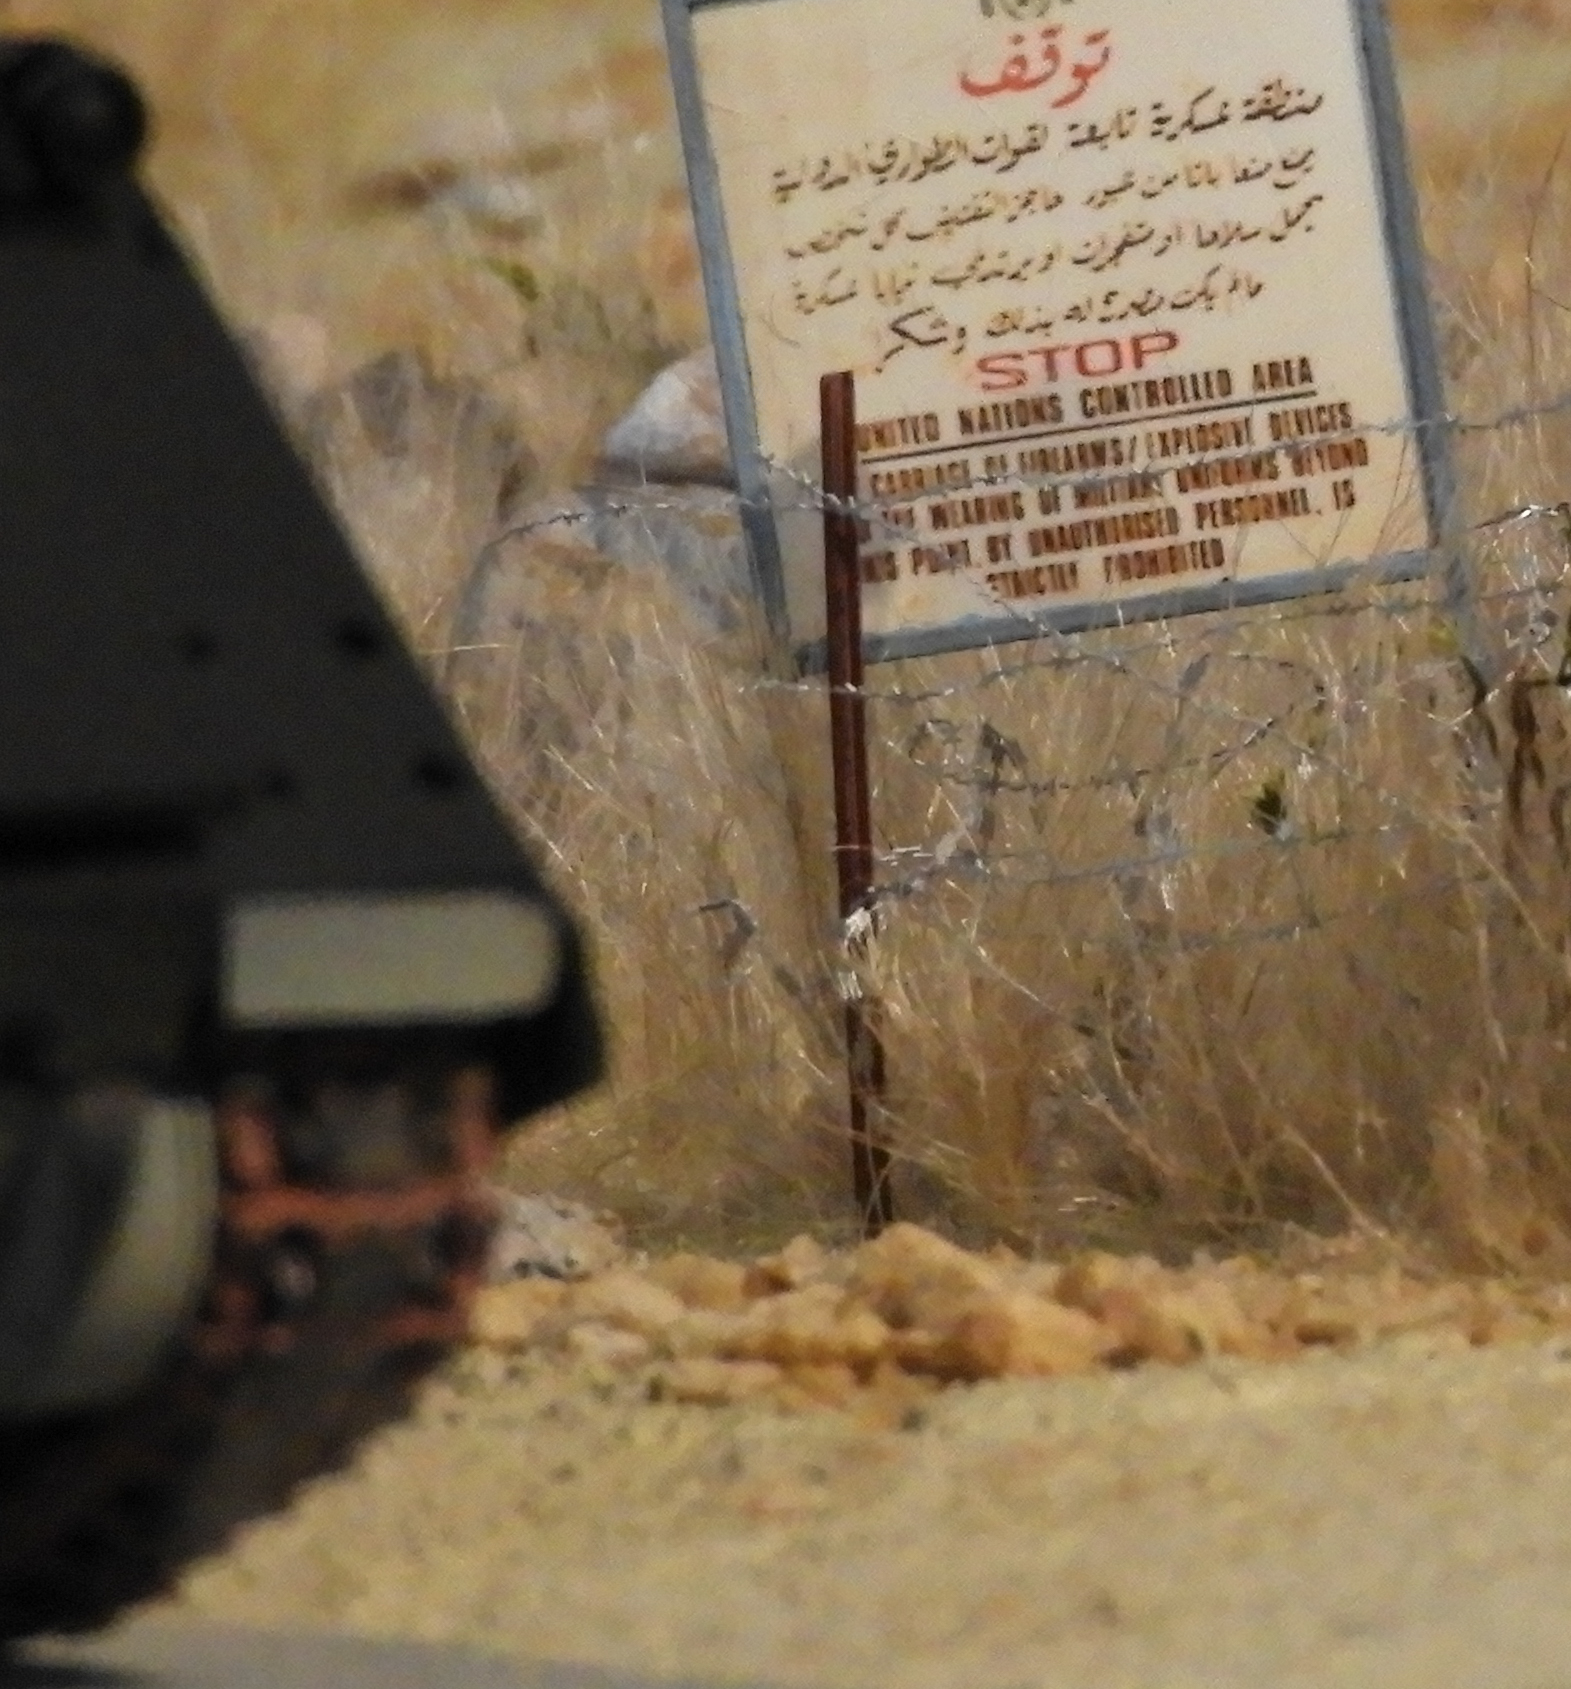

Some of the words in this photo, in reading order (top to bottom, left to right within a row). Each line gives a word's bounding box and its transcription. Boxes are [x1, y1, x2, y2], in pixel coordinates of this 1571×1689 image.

[958, 24, 1111, 110] توقف
[976, 328, 1181, 392] STOP
[855, 411, 941, 455] UNITED
[956, 392, 1065, 437] NATIONS
[1078, 366, 1234, 420] CONTROLLED
[1251, 354, 1315, 394] AREA
[1267, 400, 1355, 442] DEVICES
[928, 490, 1026, 532] WEARING
[1174, 450, 1282, 495] UNIFORMS
[1288, 435, 1370, 478] BEYOND
[1330, 478, 1358, 512] IS
